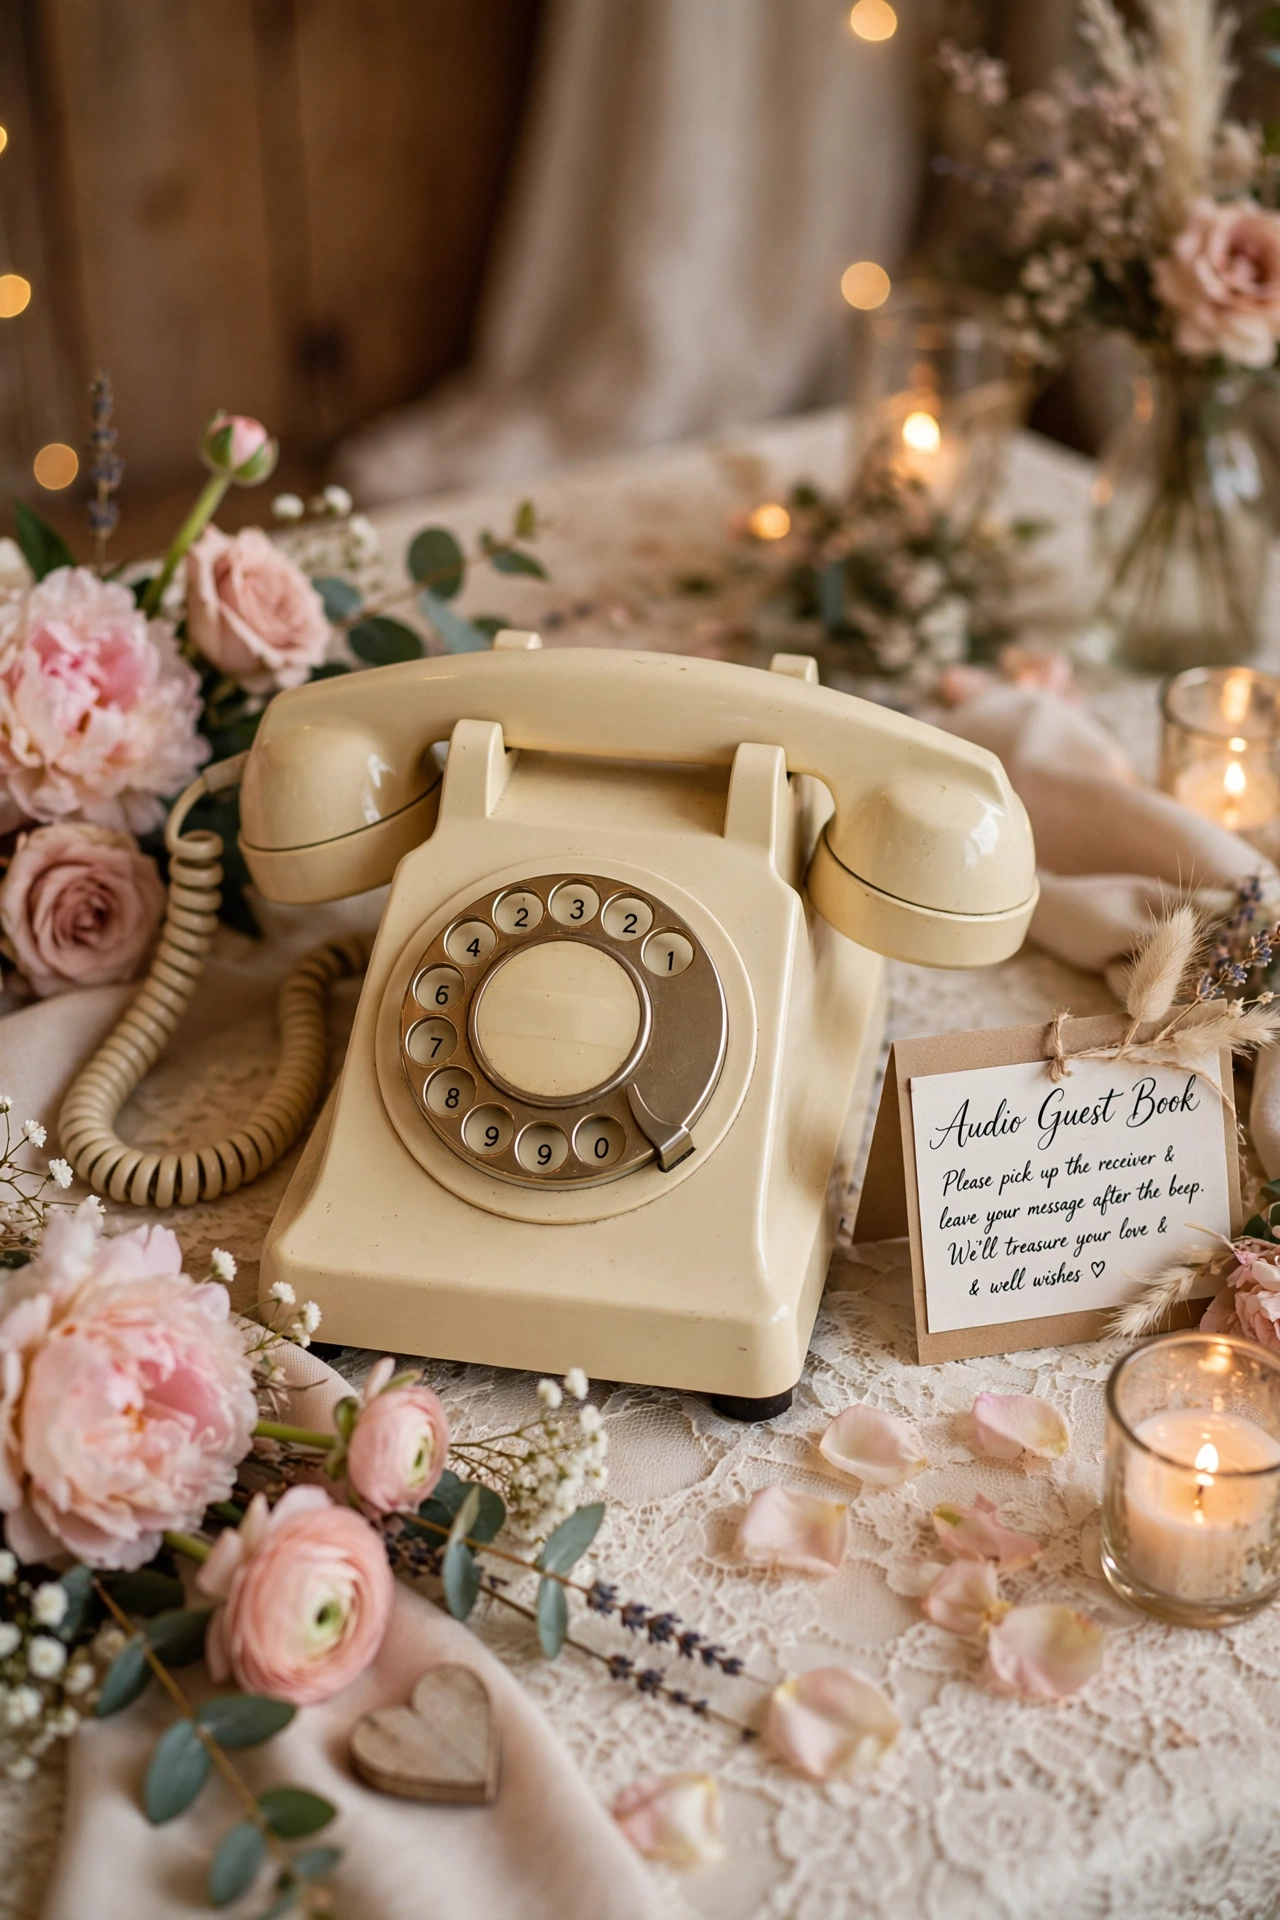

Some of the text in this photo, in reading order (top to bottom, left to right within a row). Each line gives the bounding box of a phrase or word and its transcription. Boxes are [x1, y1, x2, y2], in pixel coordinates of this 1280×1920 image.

[513, 907, 529, 928] 2
[569, 898, 585, 920] 3
[622, 913, 638, 934] 2
[465, 937, 481, 958] 4
[667, 950, 675, 972] 1
[434, 985, 450, 1006] 6
[429, 1037, 443, 1059] 7
[444, 1087, 461, 1110] 8
[929, 1073, 1201, 1151] Audio Guest Book
[484, 1126, 500, 1148] 9
[593, 1137, 610, 1159] 0
[536, 1143, 553, 1166] 9
[942, 1145, 1175, 1197] Please pick up the receiver &
[939, 1174, 1205, 1235] leave your message after the beep.
[1004, 1236, 1069, 1257] treasure
[1074, 1230, 1112, 1258] your
[1118, 1216, 1149, 1240] love
[1157, 1216, 1168, 1234] &
[968, 1261, 1084, 1296] & well wishes
